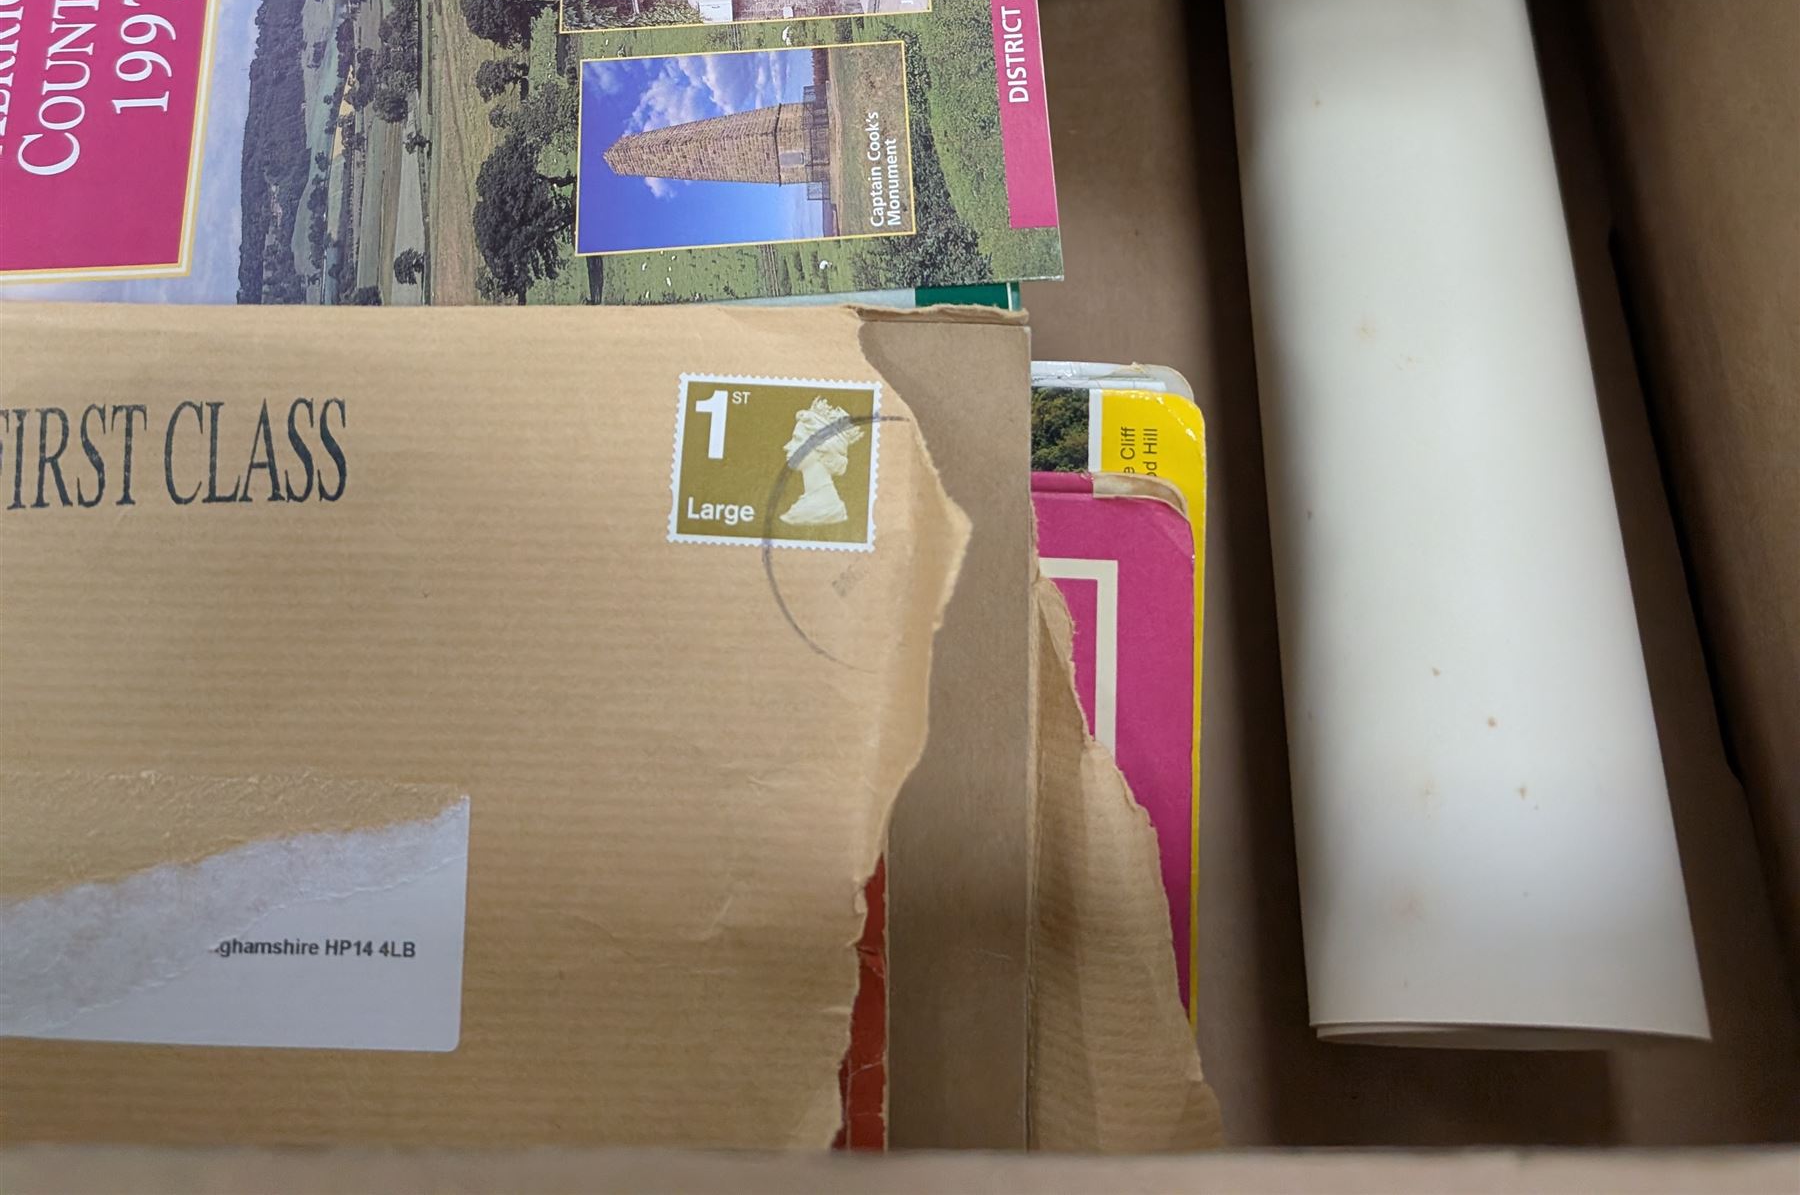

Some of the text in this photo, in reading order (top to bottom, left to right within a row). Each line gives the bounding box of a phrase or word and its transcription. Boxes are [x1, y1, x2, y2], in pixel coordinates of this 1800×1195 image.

[1001, 6, 1030, 103] DISTRICT
[864, 111, 887, 228] Captain Cook's
[884, 138, 902, 227] Monument
[0, 396, 348, 510] IRST CLASS
[1120, 426, 1136, 460] Cliff
[1142, 428, 1158, 455] Hill
[686, 496, 756, 526] Large
[215, 938, 416, 959] ghamshire HP14 4LB
